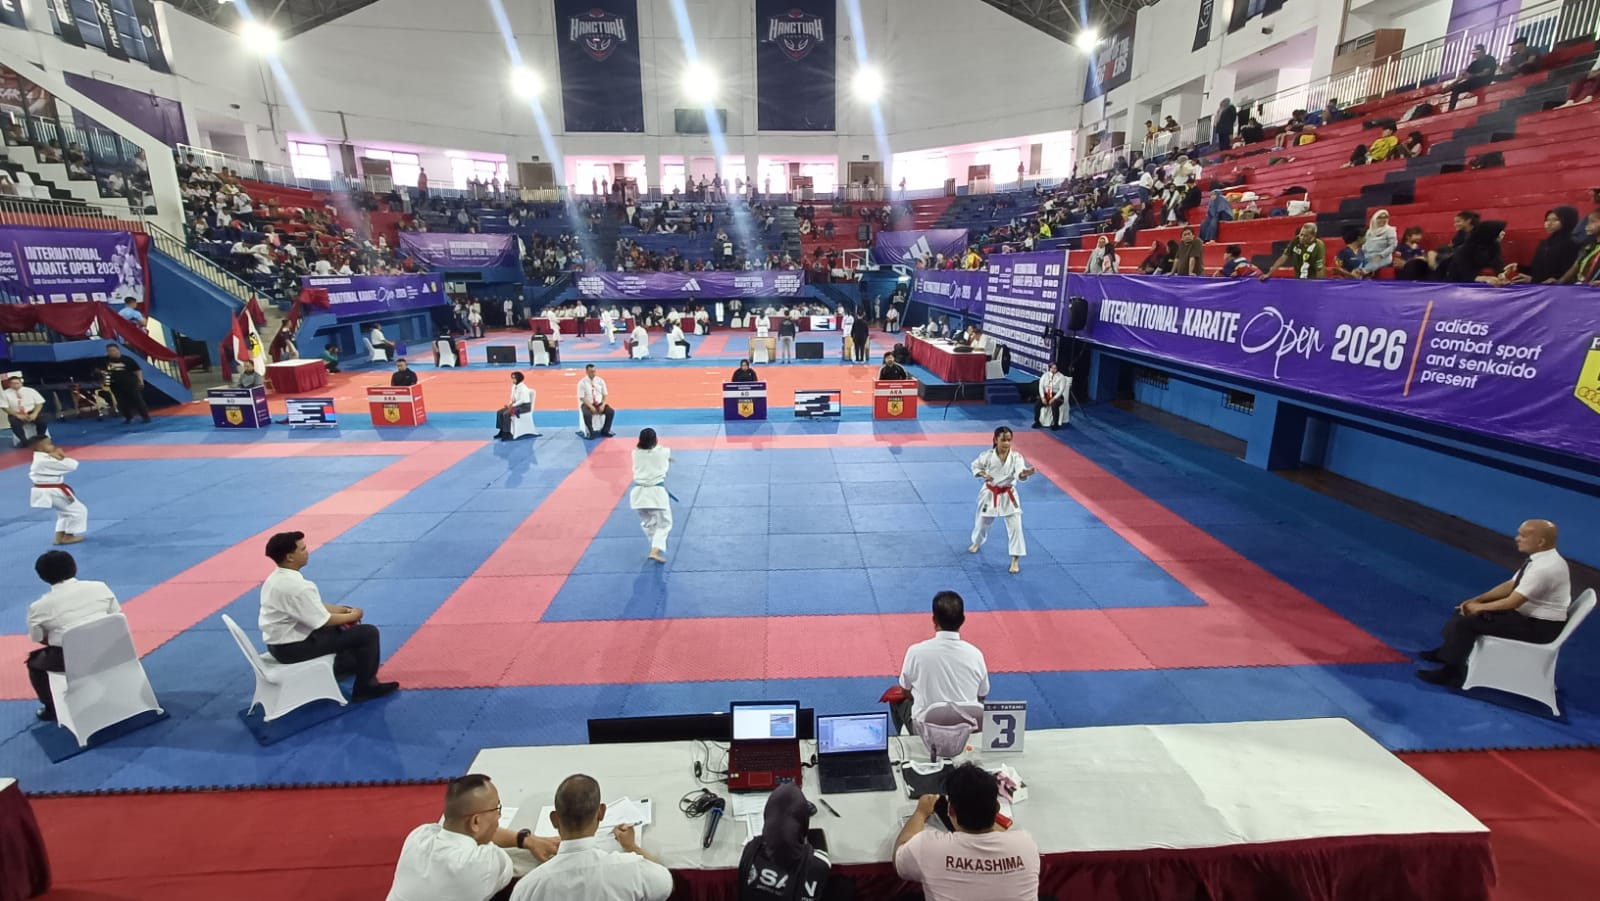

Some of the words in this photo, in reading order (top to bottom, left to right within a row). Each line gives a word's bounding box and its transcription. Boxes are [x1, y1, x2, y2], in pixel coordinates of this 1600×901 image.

[570, 18, 627, 41] HANGTUAH
[769, 18, 824, 41] HANGTUAH
[24, 246, 101, 260] INTERNATIONAL
[28, 262, 68, 275] KARATE
[69, 262, 96, 275] OPEN
[96, 262, 121, 275] 2026
[1099, 299, 1178, 334] INTERNATIONAL
[1181, 309, 1241, 343] KARATE
[1240, 306, 1325, 379] Open
[1331, 324, 1408, 371] 2026
[1435, 320, 1489, 336] adidas
[1430, 337, 1493, 355] combat
[1496, 344, 1542, 361] sport
[1426, 353, 1457, 368] and
[1459, 357, 1537, 379] senkaido
[1420, 369, 1478, 389] present
[991, 714, 1016, 748] 3
[946, 855, 1024, 871] RAKASHIMA
